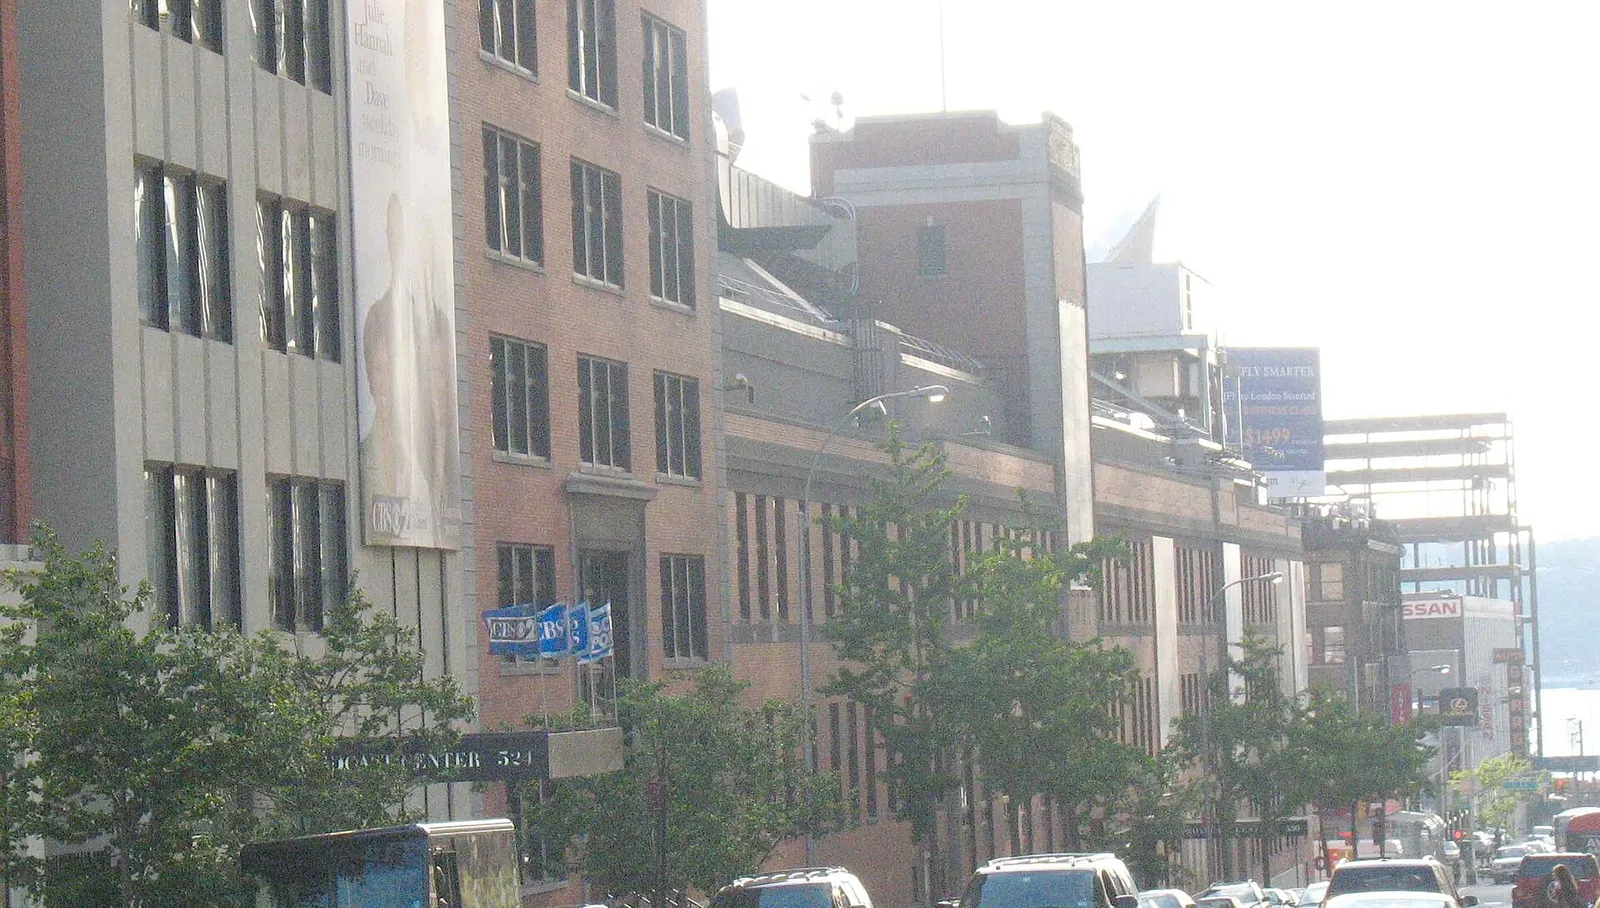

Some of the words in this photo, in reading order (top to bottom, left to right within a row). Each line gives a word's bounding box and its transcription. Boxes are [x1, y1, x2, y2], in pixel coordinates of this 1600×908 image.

[354, 22, 395, 60] Hannah,
[1241, 366, 1260, 376] FLY
[1263, 366, 1315, 377] SMARTER
[1251, 391, 1281, 402] London
[1402, 602, 1457, 617] SSAN
